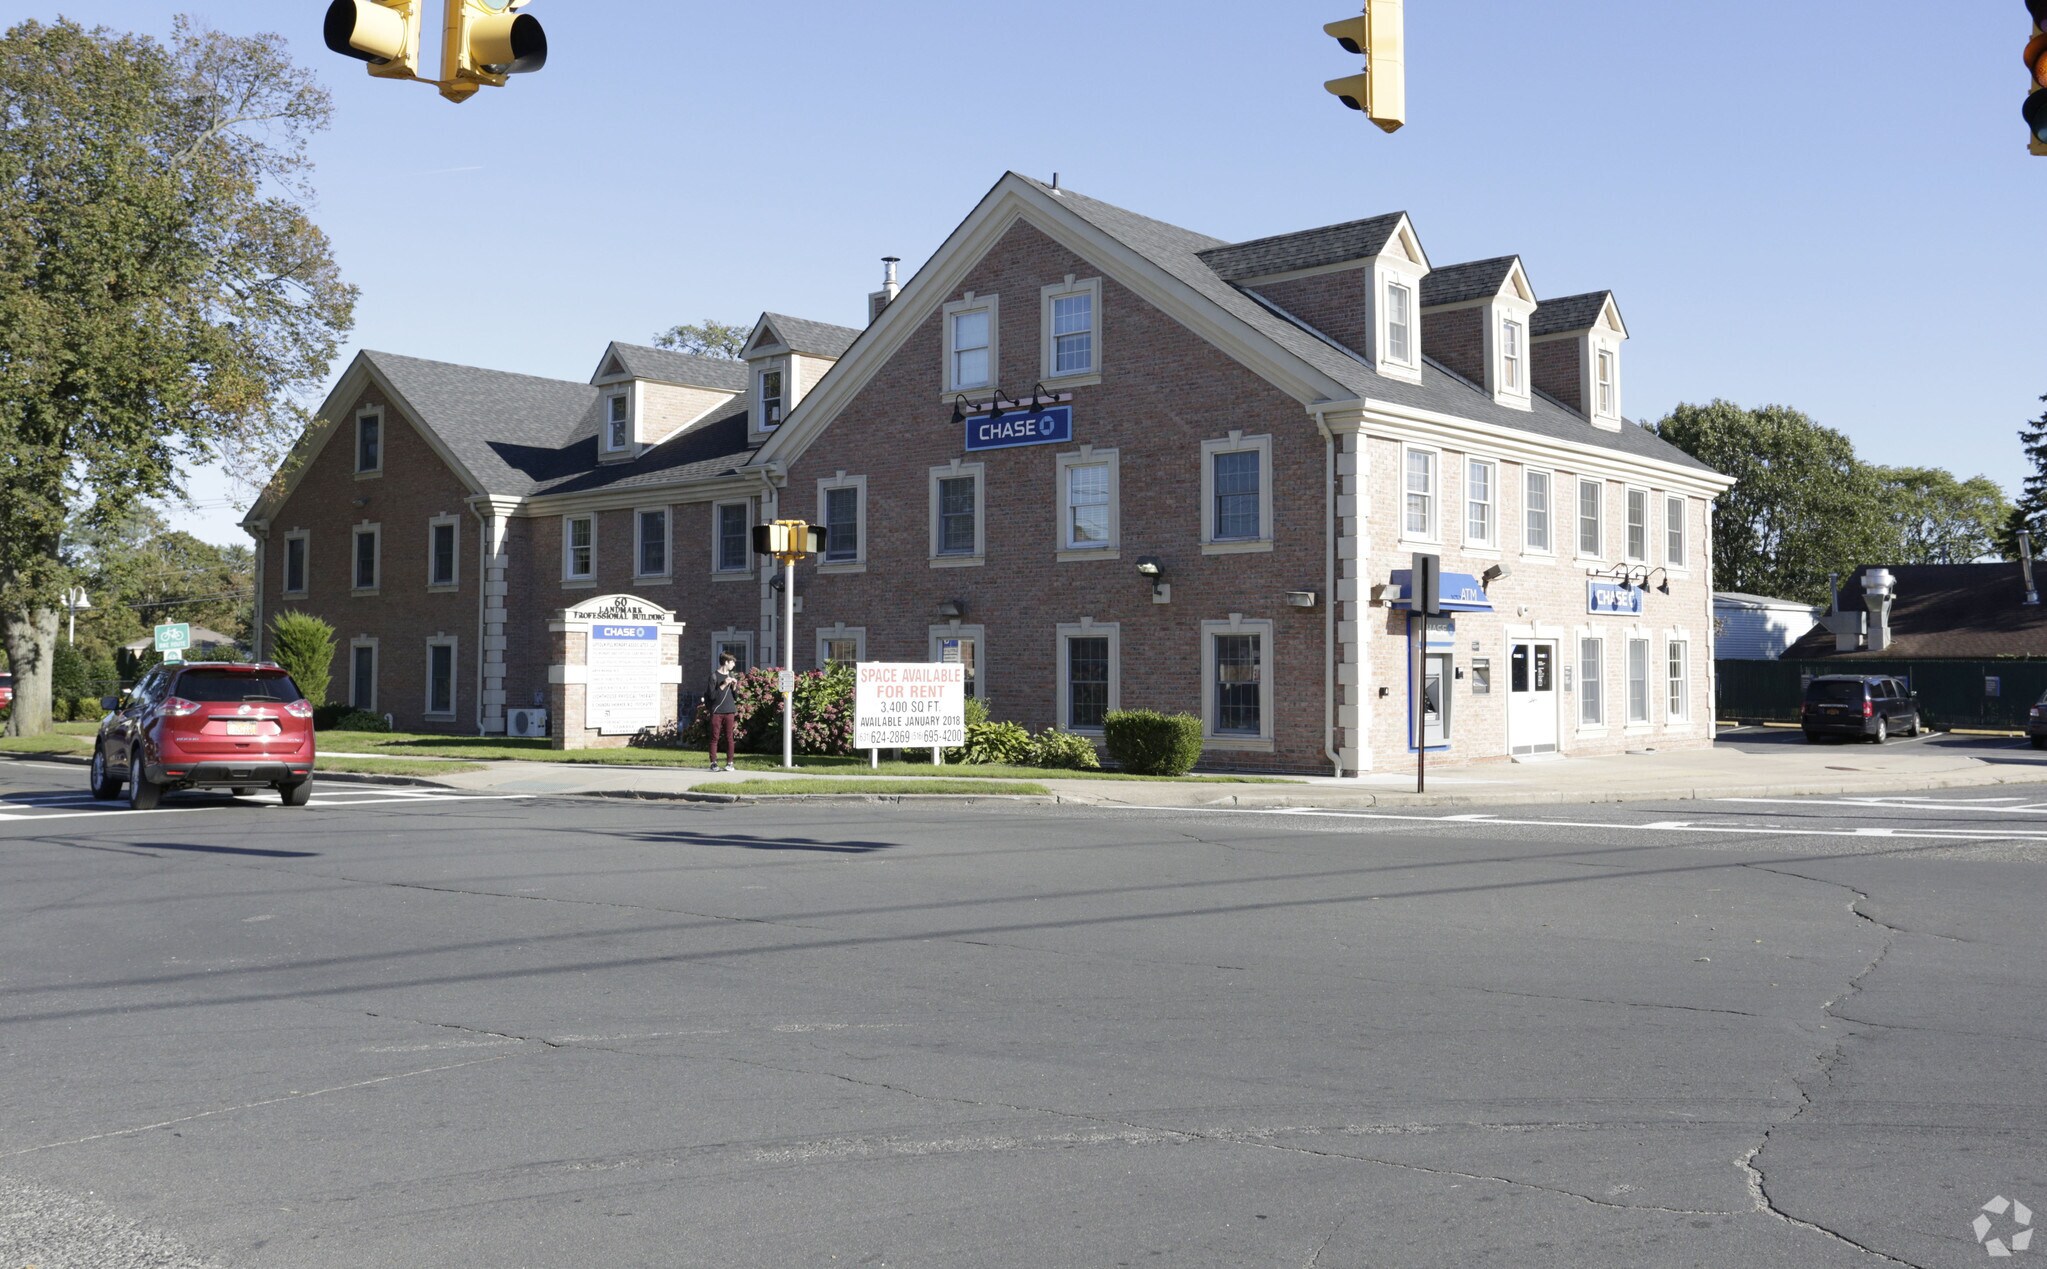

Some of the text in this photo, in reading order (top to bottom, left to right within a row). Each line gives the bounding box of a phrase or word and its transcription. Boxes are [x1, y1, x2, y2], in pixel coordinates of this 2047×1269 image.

[979, 419, 1036, 440] CHASE
[1461, 588, 1478, 601] ATM
[1597, 589, 1628, 606] CHASE
[614, 597, 627, 607] 60
[574, 611, 665, 621] PROFESSIONAL BUILDING
[599, 606, 642, 614] LANDMARK
[604, 628, 635, 636] CHASE
[861, 668, 961, 683] SPACE AVAILABLE
[877, 685, 945, 698] FOR RENT
[911, 701, 924, 713] SQ
[860, 715, 961, 727] AVAILABLE JANUARY 2018
[870, 730, 910, 744] 624-2869
[923, 729, 962, 743] 695-4200
